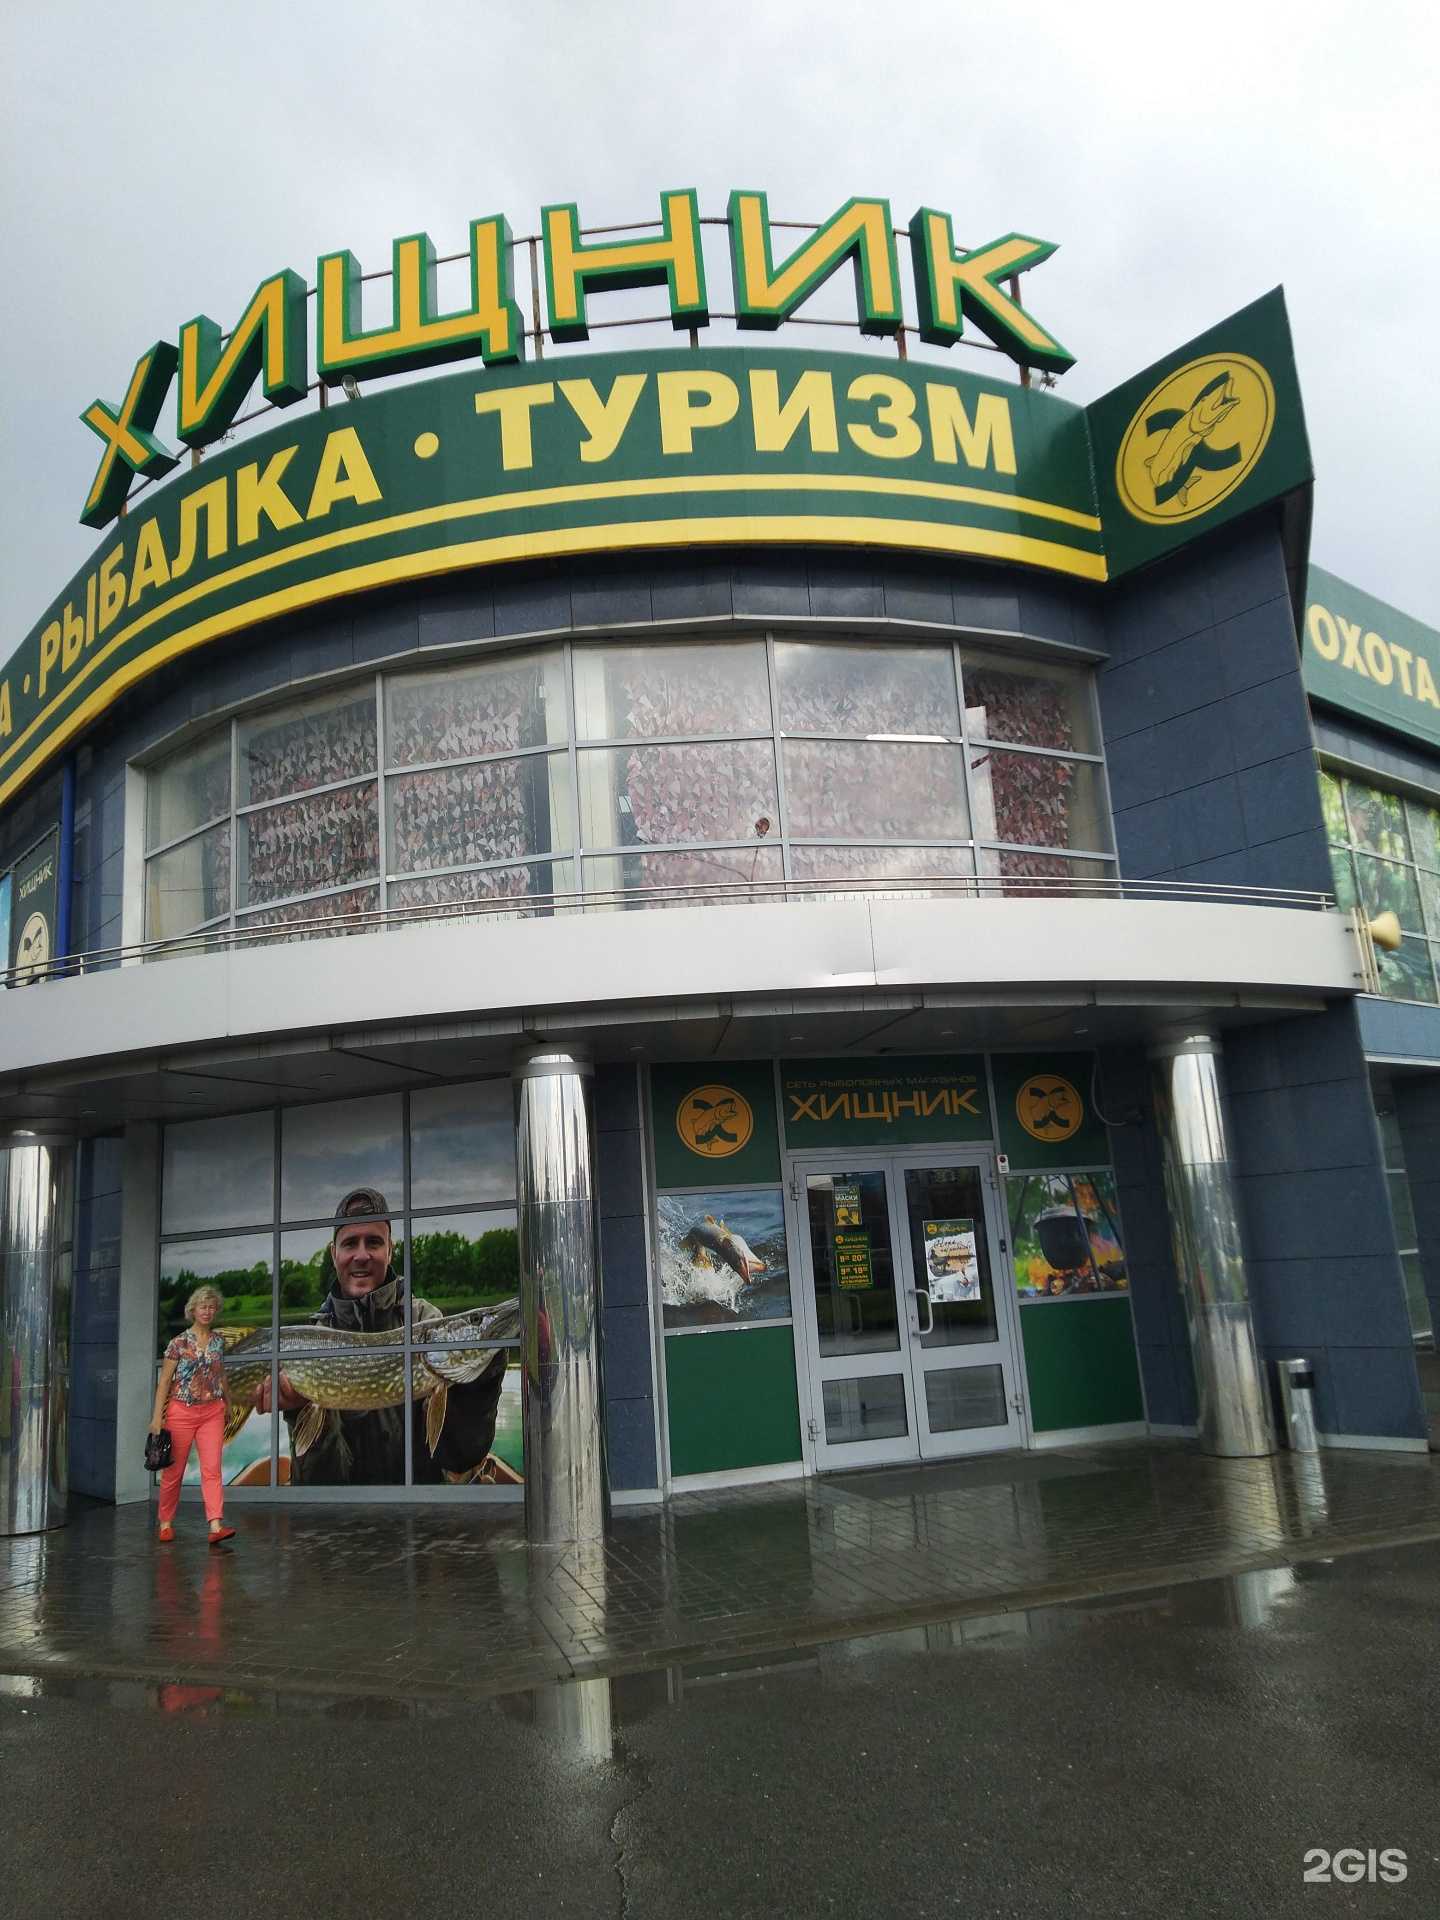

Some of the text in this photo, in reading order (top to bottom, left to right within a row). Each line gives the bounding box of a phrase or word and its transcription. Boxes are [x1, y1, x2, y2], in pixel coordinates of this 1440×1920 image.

[79, 187, 1076, 530] ХИЩНИК
[38, 426, 383, 699] РЫБАЛКА
[474, 369, 1018, 476] ТУРИЗМ
[1307, 603, 1440, 709] ОХОТА
[789, 1088, 982, 1122] ХИЩНИК
